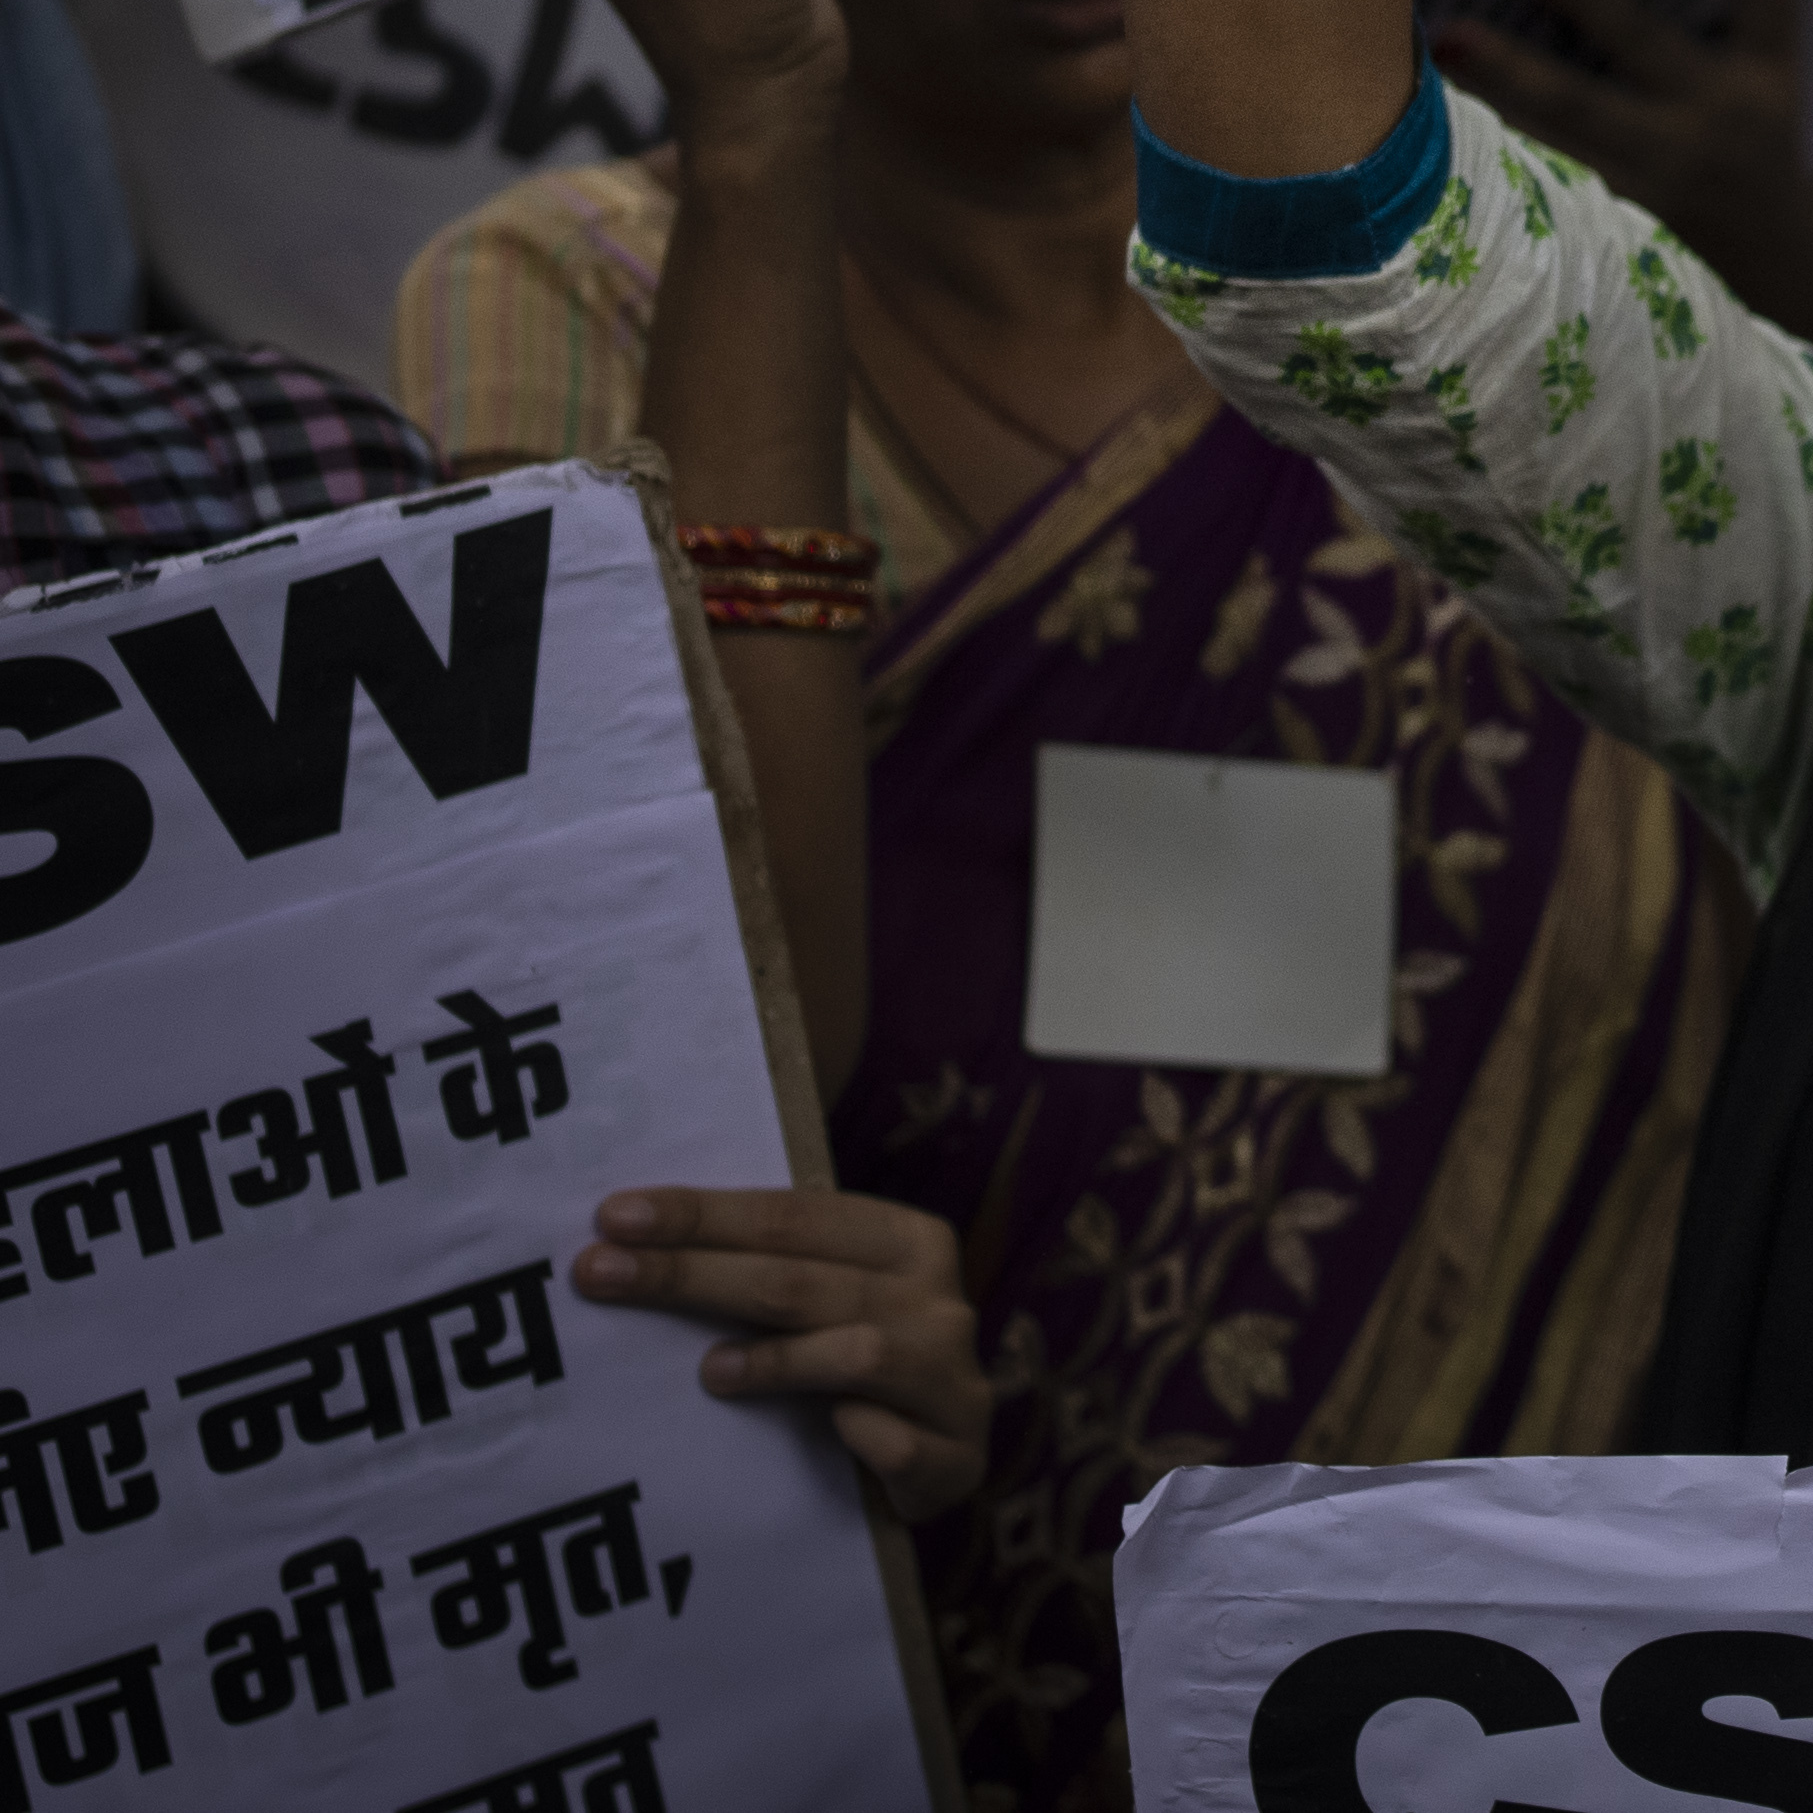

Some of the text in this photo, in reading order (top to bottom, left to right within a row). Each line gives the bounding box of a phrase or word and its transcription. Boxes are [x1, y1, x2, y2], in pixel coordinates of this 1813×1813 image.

[0, 988, 571, 1301] लाओं के
[176, 1259, 567, 1476] न्याय
[203, 1536, 397, 1727] भी
[411, 1480, 694, 1693] मृत,
